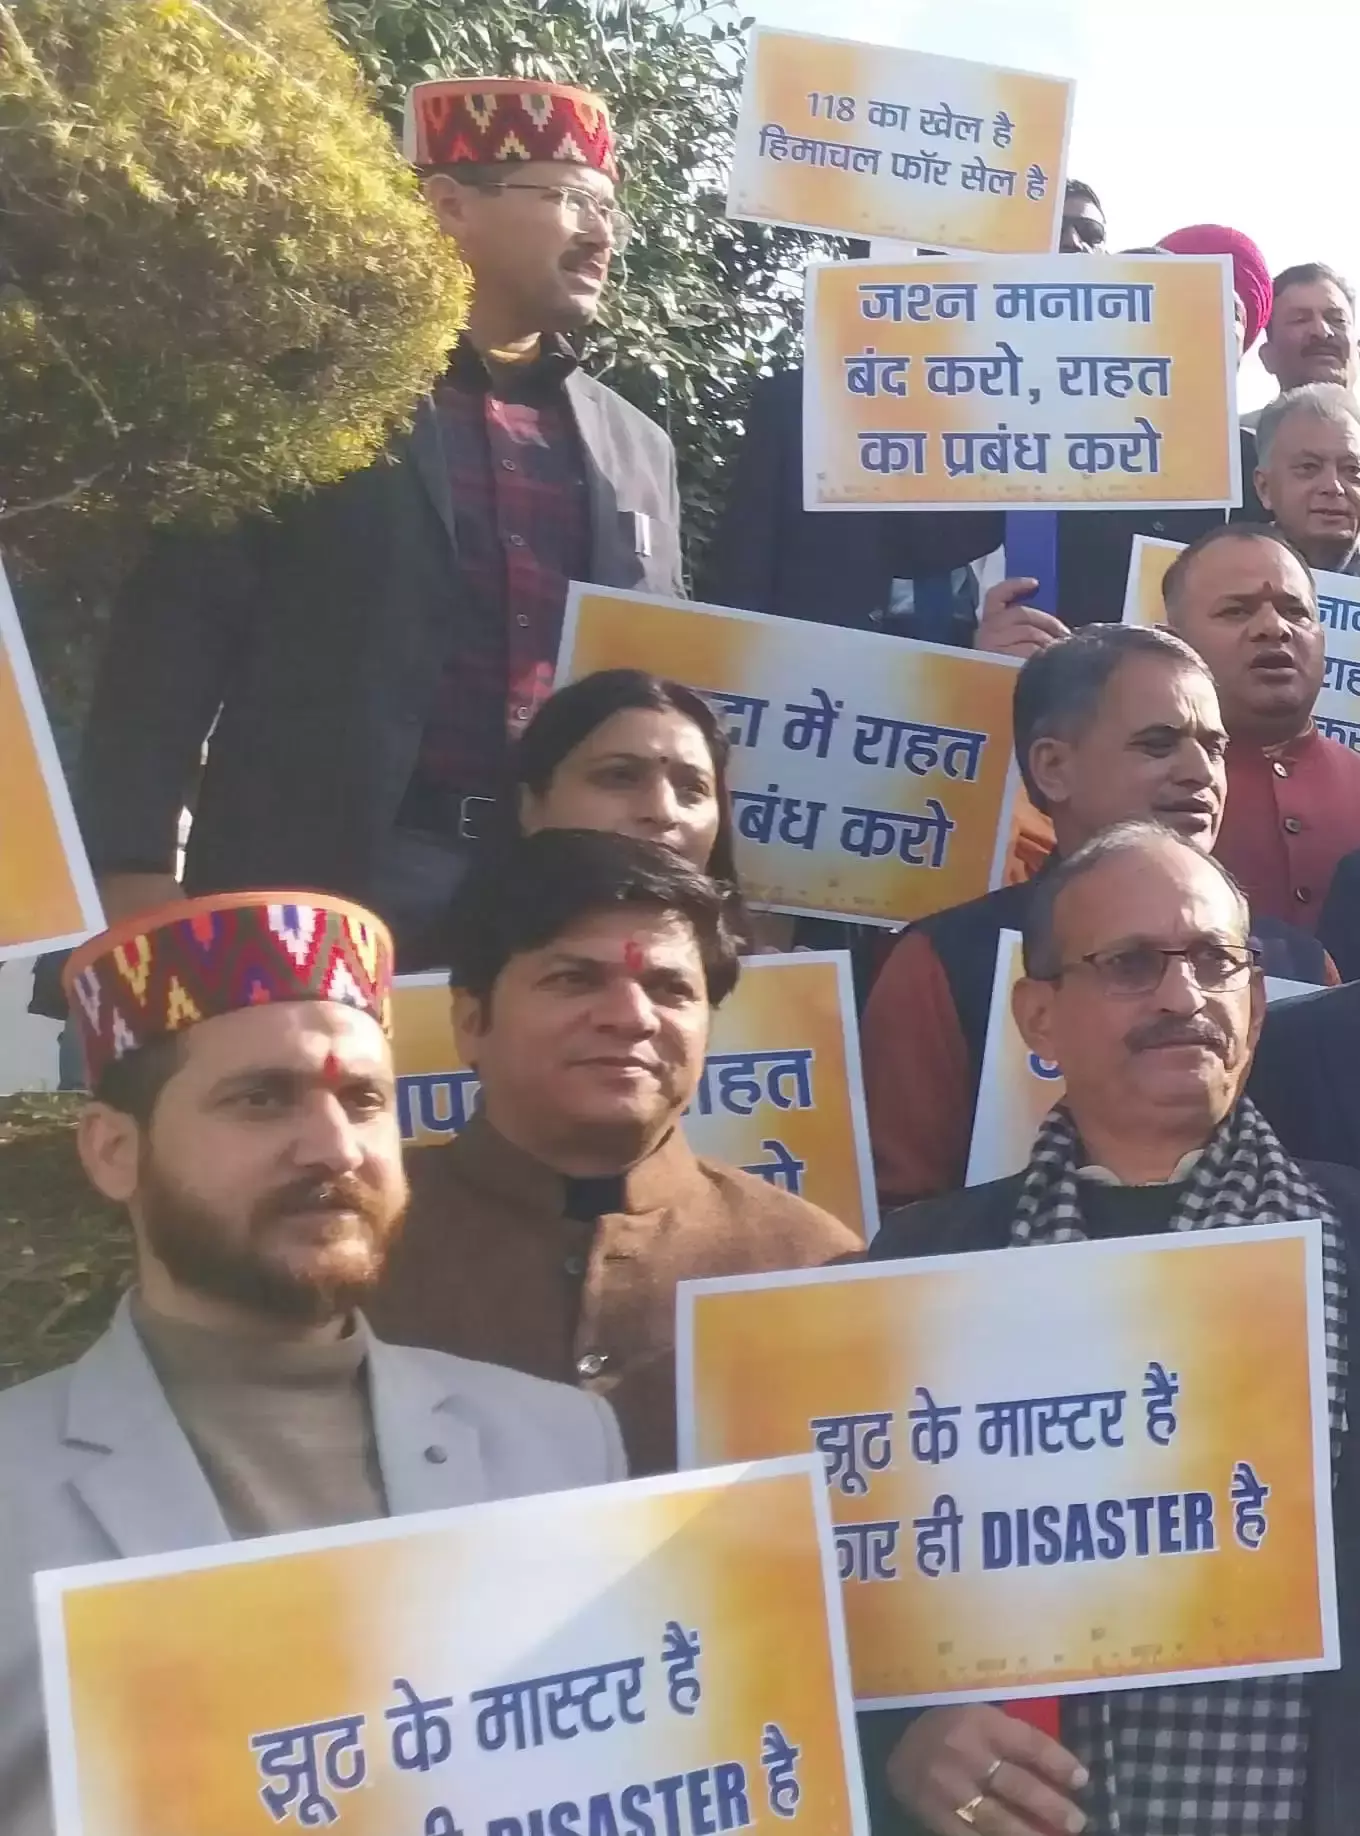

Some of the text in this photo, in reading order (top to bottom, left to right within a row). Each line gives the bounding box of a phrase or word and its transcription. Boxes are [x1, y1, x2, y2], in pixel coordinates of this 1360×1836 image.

[759, 124, 1048, 200] हिमाचल फॉर सेल है
[807, 91, 1015, 149] 118 का खेल है
[858, 283, 1154, 323] जश्न मनाना
[845, 342, 1171, 405] बंद करो, राहत
[859, 417, 1162, 478] का प्रबंध करो
[783, 687, 844, 758] में
[853, 715, 988, 781] राहत
[730, 784, 955, 868] बंध करो
[811, 1361, 1179, 1494] झूठ के मास्टर हैं
[913, 1494, 962, 1577] ही
[982, 1492, 1215, 1571] DISASTER
[1231, 1462, 1270, 1548] है
[251, 1621, 701, 1826] झूठ के मास्टर हैं
[761, 1724, 800, 1816] है
